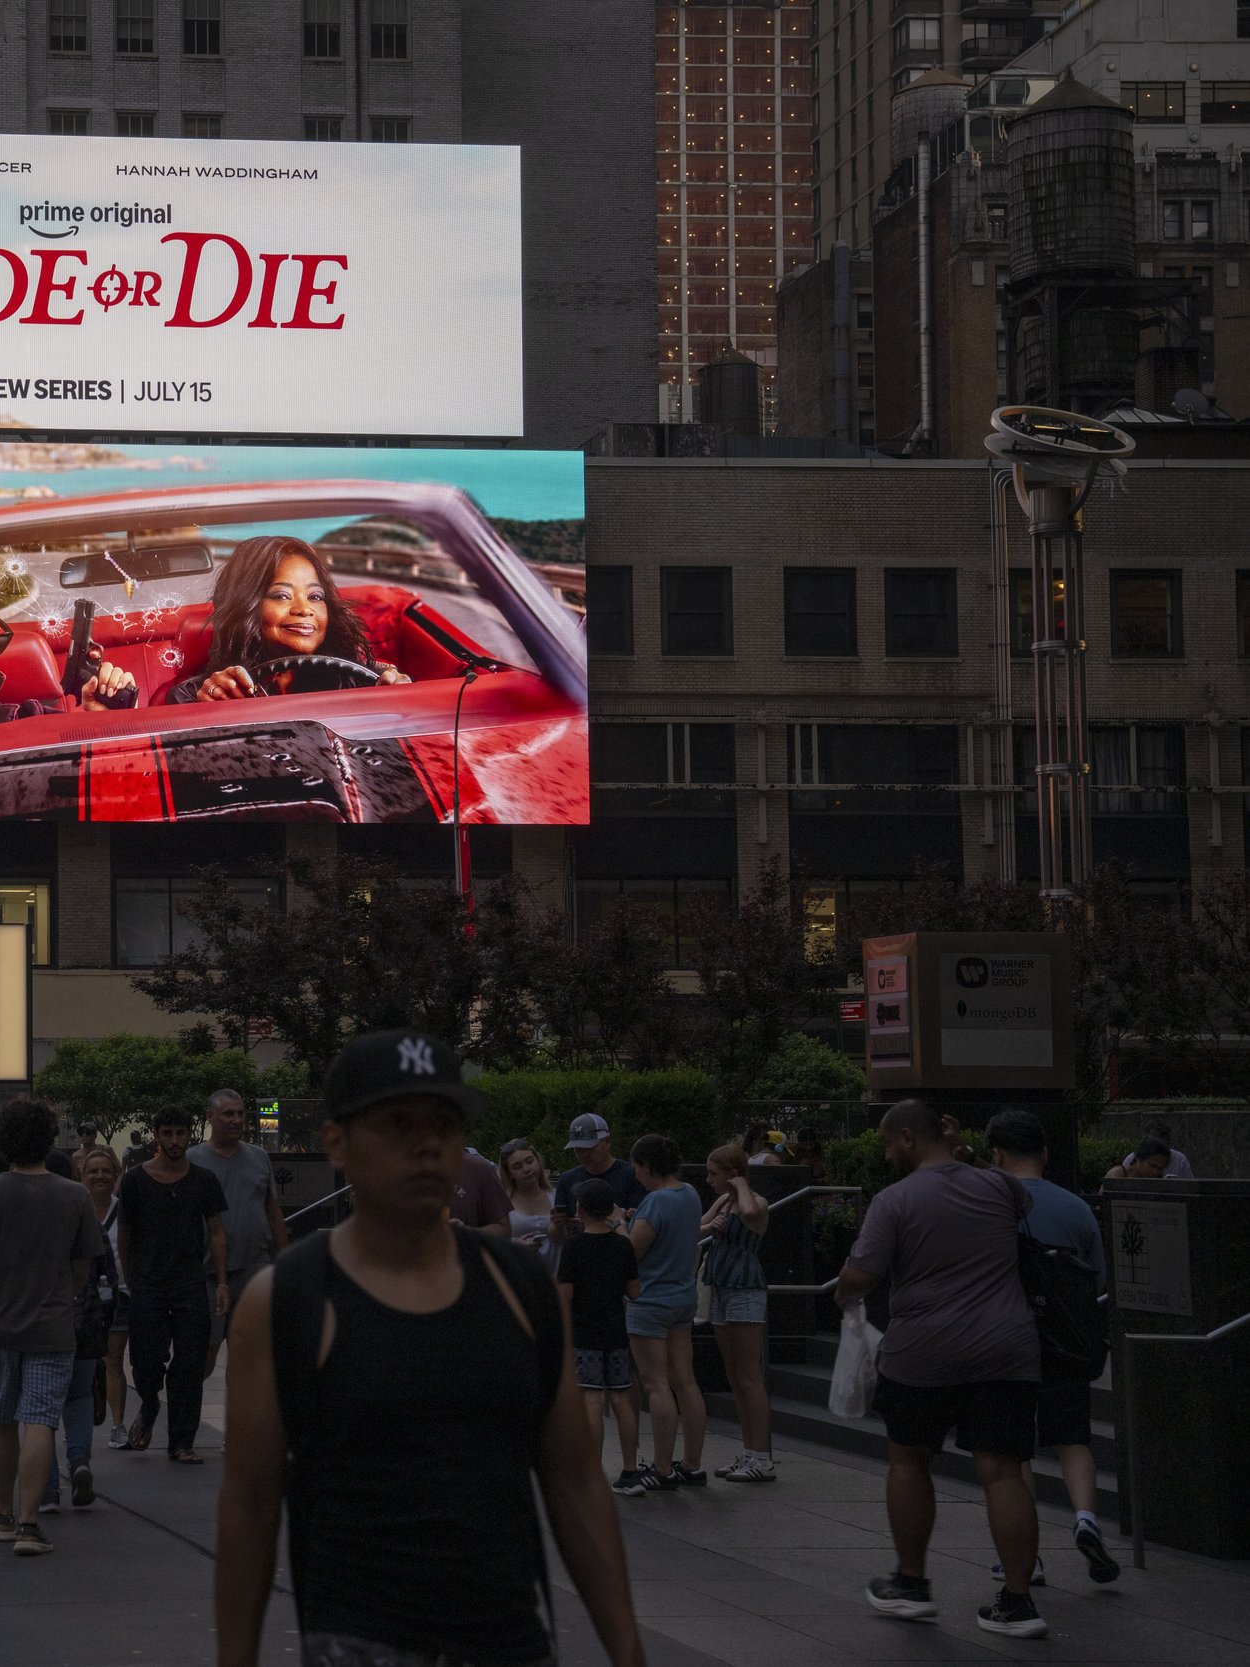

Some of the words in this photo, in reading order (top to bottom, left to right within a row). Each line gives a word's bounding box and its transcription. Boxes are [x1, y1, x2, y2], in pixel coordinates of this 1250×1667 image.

[116, 164, 191, 178] HANNAH
[196, 167, 319, 181] WADDINGHAM
[20, 200, 85, 225] prime
[90, 202, 172, 228] original
[90, 264, 162, 312] OR
[161, 230, 348, 330] DIE
[34, 379, 112, 401] SERIES
[133, 381, 188, 403] JULY
[190, 383, 212, 403] 15
[990, 959, 1035, 969] WARNER
[991, 968, 1024, 977] MUSIC
[991, 978, 1029, 987] GROUP
[970, 1006, 1037, 1021] mongoDB
[396, 1036, 437, 1076] NY
